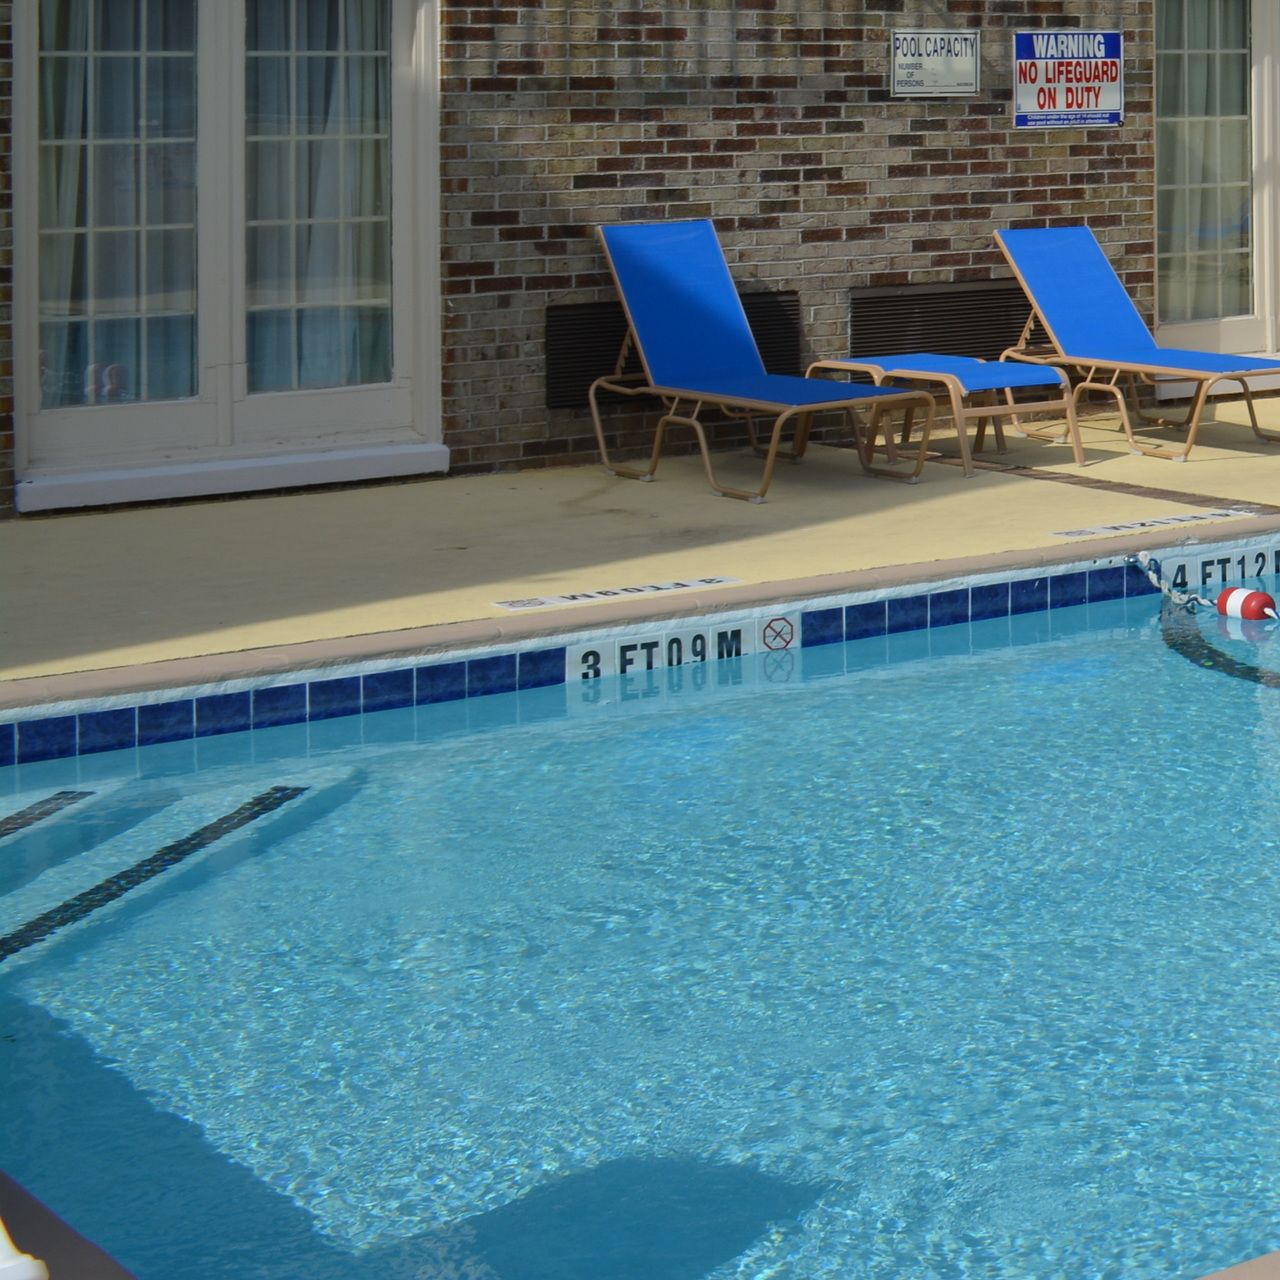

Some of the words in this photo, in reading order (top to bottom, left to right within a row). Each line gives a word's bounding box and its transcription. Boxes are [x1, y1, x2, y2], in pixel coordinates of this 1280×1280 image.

[895, 37, 923, 58] POOL
[925, 37, 976, 58] CAPACITY
[1033, 33, 1105, 59] WARNING
[896, 80, 925, 88] PERSONS
[906, 71, 915, 79] OF
[1019, 61, 1038, 85] NO
[1045, 60, 1119, 84] LIFEGUARD
[1037, 87, 1057, 110] ON
[1066, 86, 1102, 109] DUTY
[1172, 563, 1188, 589] 4
[582, 650, 601, 680] 3
